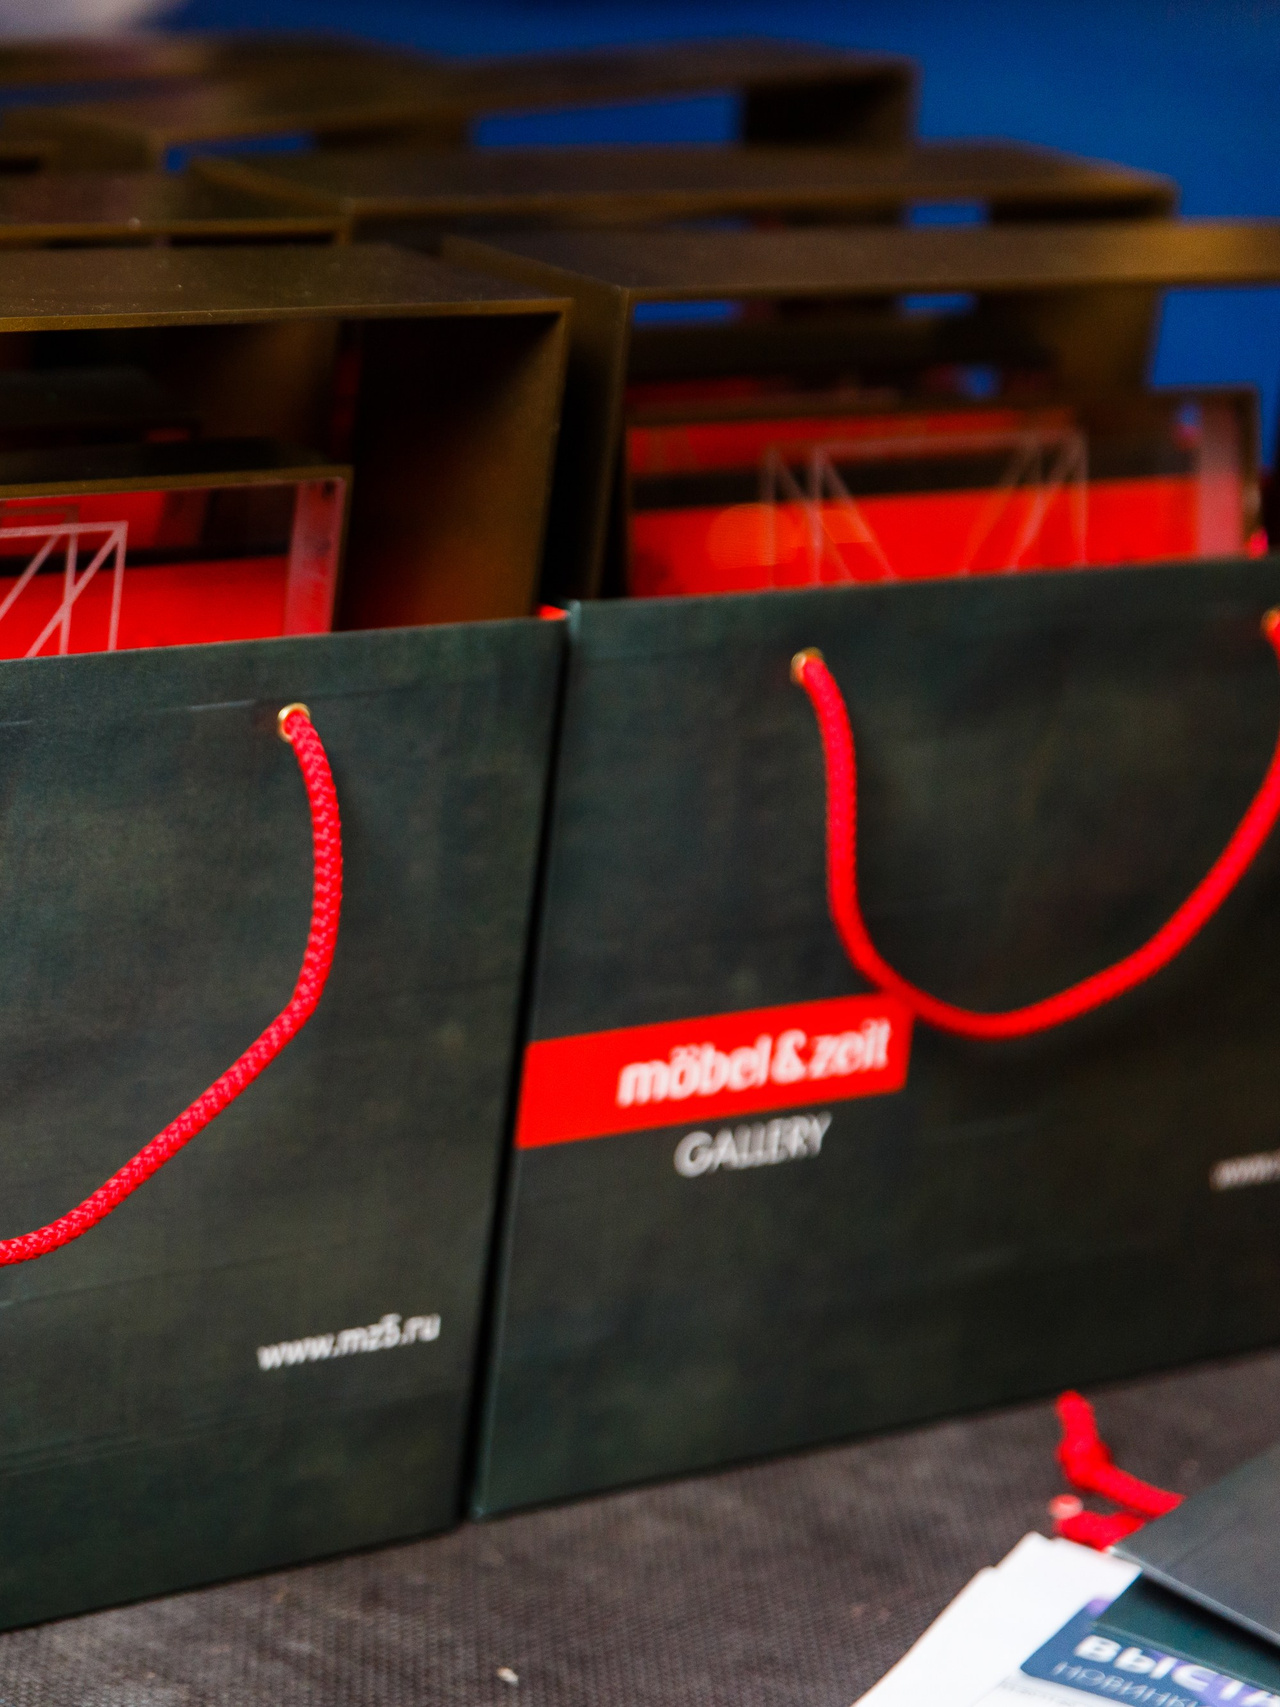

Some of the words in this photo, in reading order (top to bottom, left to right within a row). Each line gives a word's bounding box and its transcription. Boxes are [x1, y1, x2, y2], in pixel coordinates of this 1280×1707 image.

[617, 1034, 770, 1106] möbel
[772, 1030, 807, 1084] &
[811, 1019, 890, 1079] zeit
[675, 1113, 831, 1176] GALLERY
[257, 1313, 441, 1371] www.mz5.ru
